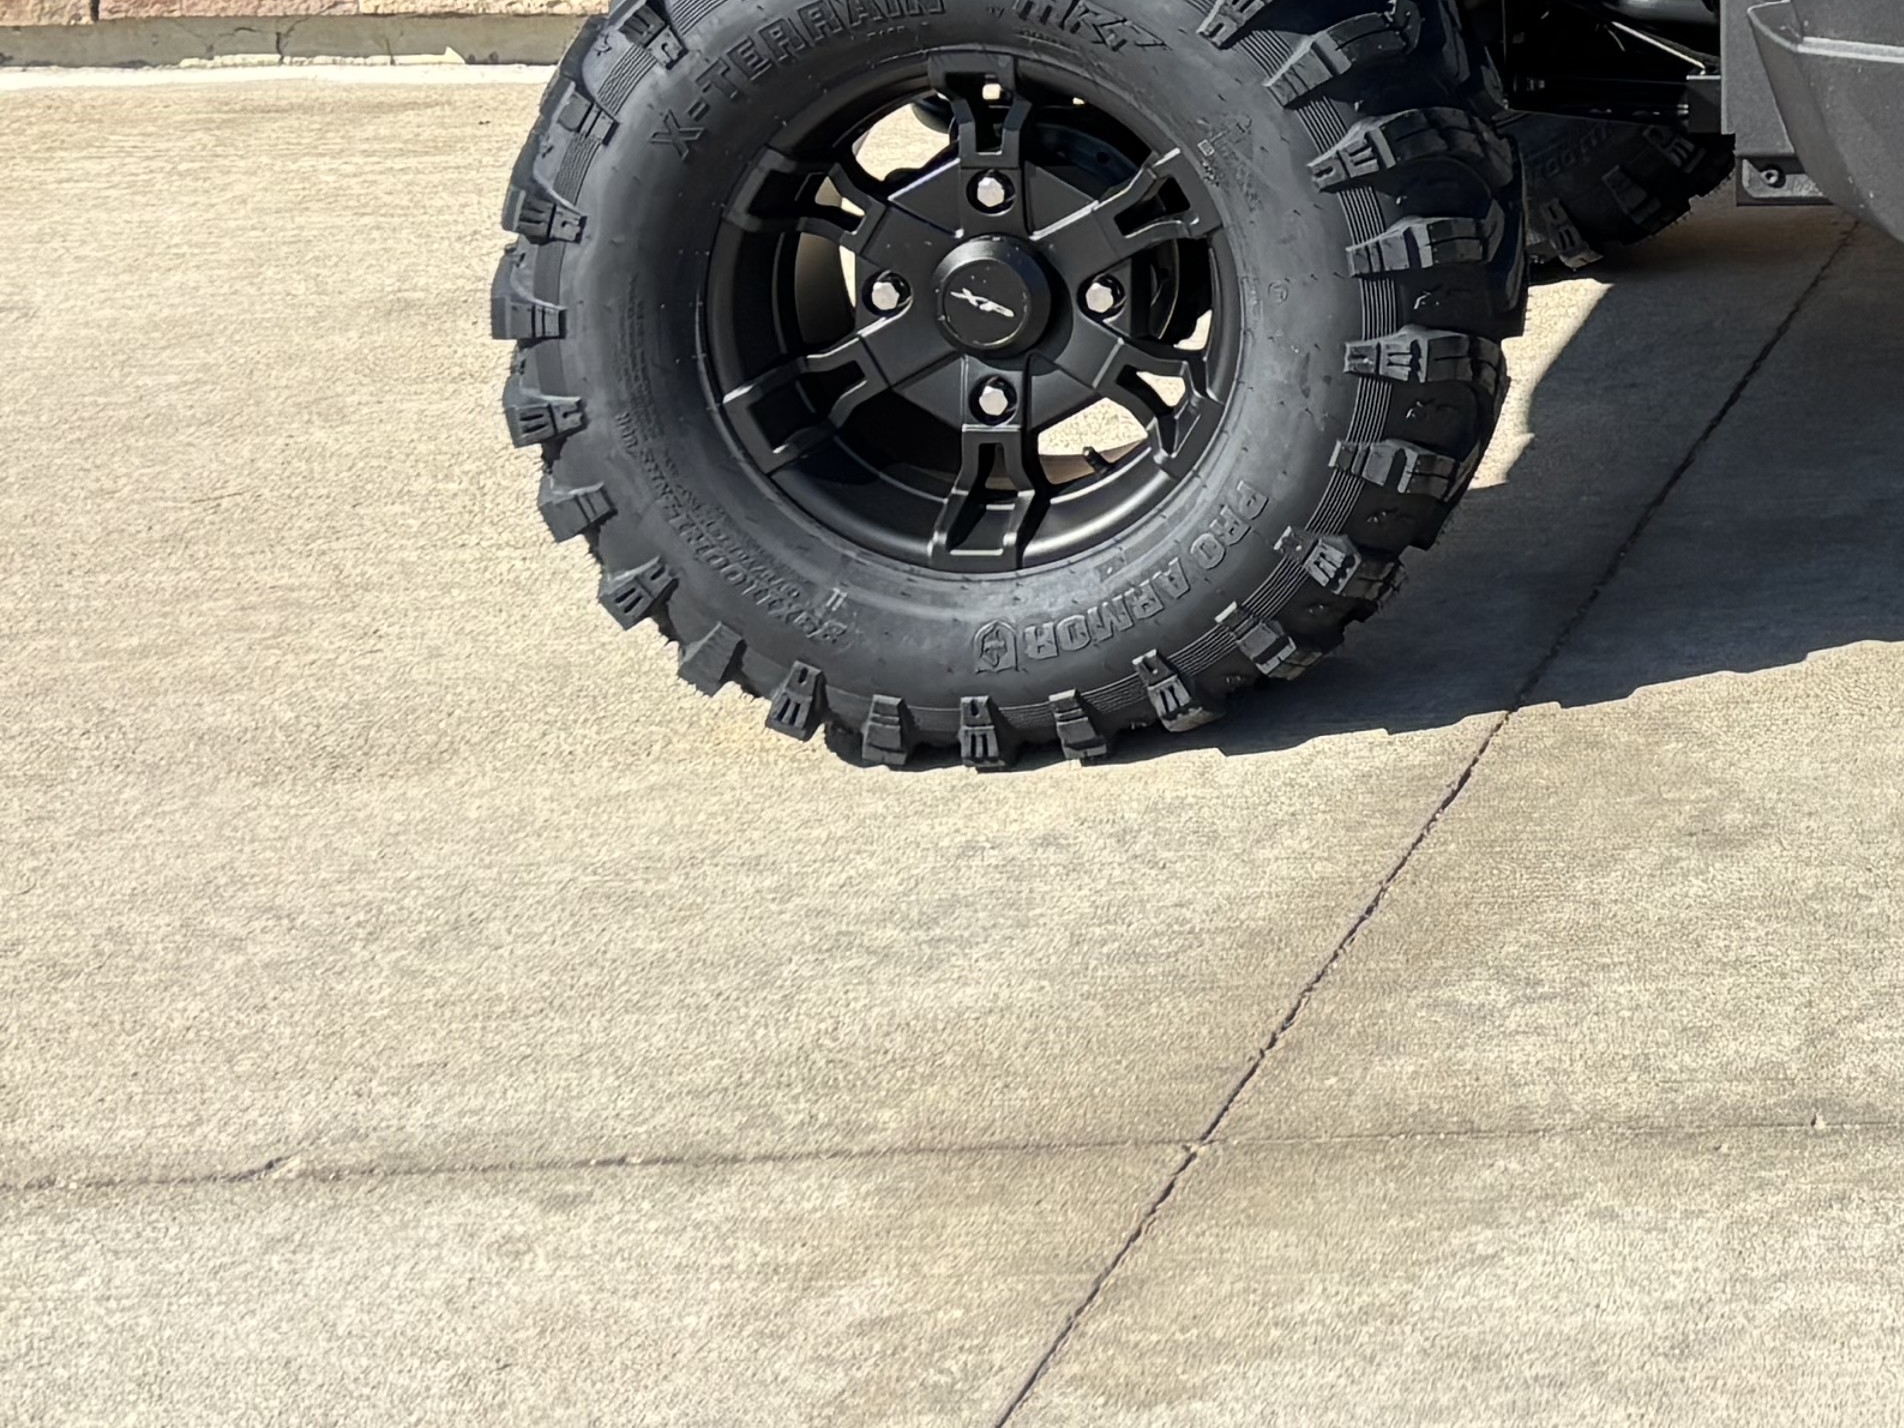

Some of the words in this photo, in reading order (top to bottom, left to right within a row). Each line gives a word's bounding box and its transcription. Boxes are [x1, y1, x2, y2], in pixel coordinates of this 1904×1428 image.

[949, 287, 1015, 318] XP
[1190, 480, 1269, 571] PRO
[1023, 557, 1191, 660] ARMOR
